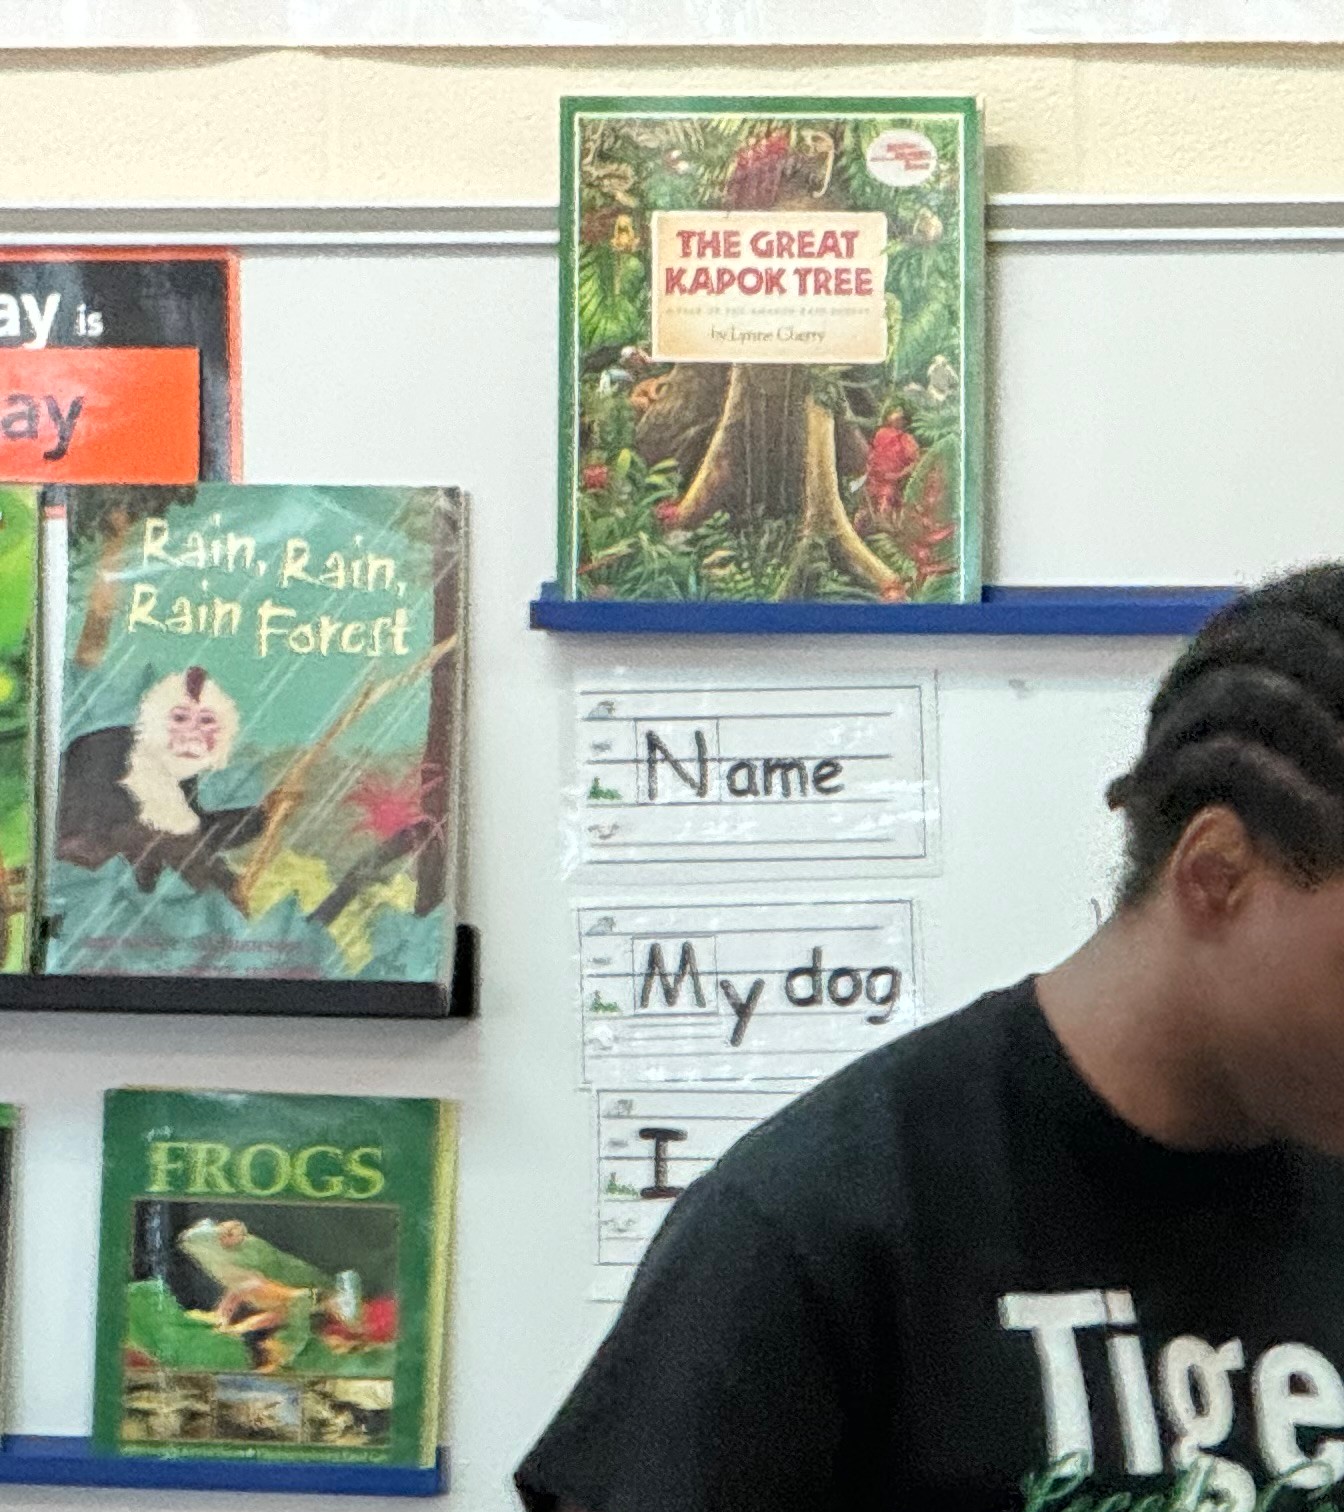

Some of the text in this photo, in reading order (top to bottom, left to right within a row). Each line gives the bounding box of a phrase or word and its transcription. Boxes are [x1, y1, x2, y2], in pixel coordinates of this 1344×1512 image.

[676, 230, 859, 258] THE GREAT
[665, 267, 873, 295] KAPOK TREE
[76, 302, 104, 338] is
[143, 513, 407, 593] Rain, Rain,
[128, 579, 413, 659] Rain Forest
[645, 730, 846, 799] Name
[639, 942, 902, 1047] My dog
[145, 1141, 385, 1199] FROGS
